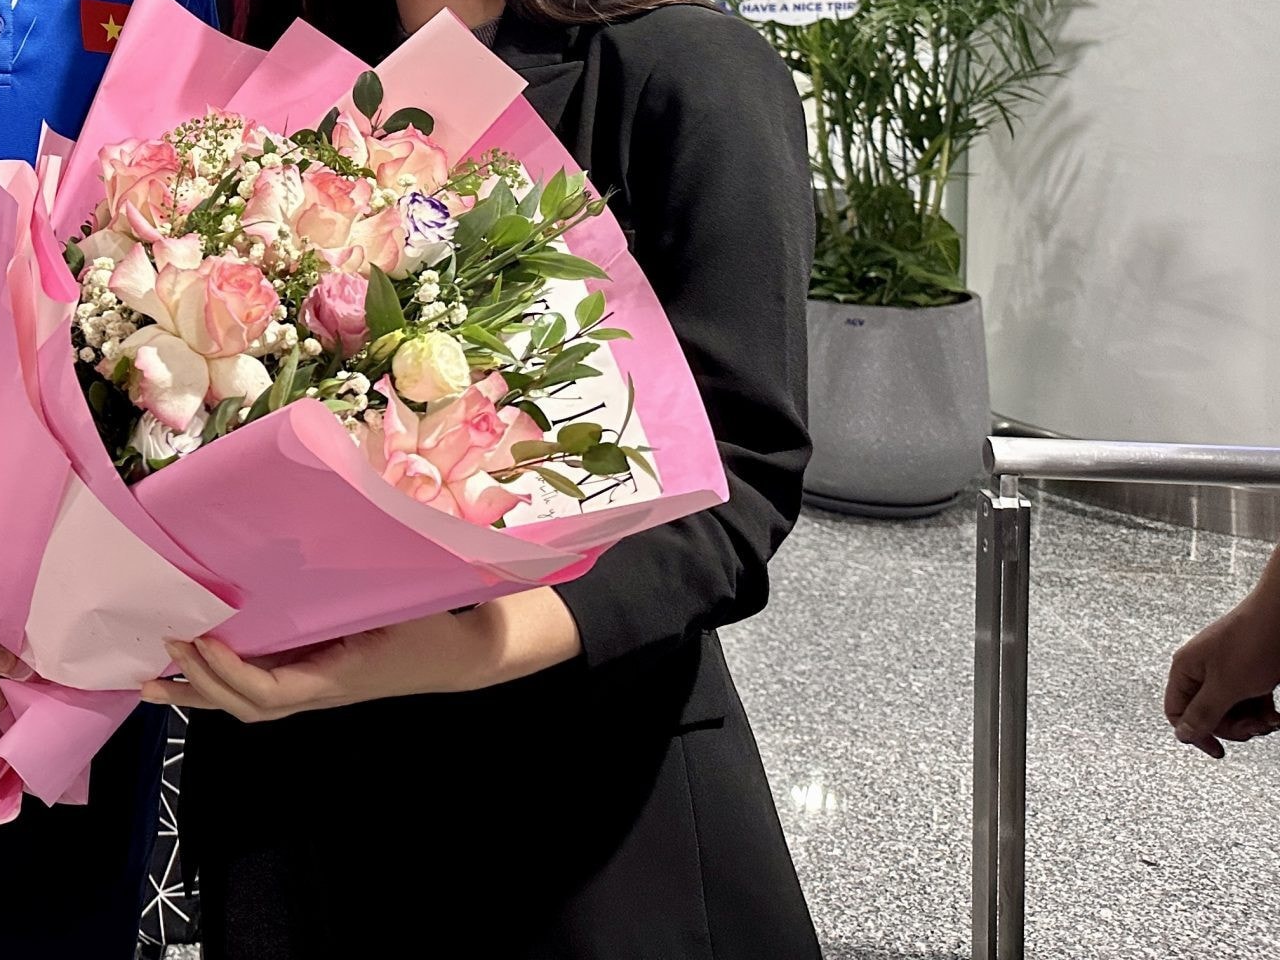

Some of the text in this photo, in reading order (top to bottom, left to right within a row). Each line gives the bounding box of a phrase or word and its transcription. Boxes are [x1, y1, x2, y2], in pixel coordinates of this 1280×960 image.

[742, 3, 776, 13] HAVE
[780, 3, 789, 12] A
[793, 3, 822, 12] NICE
